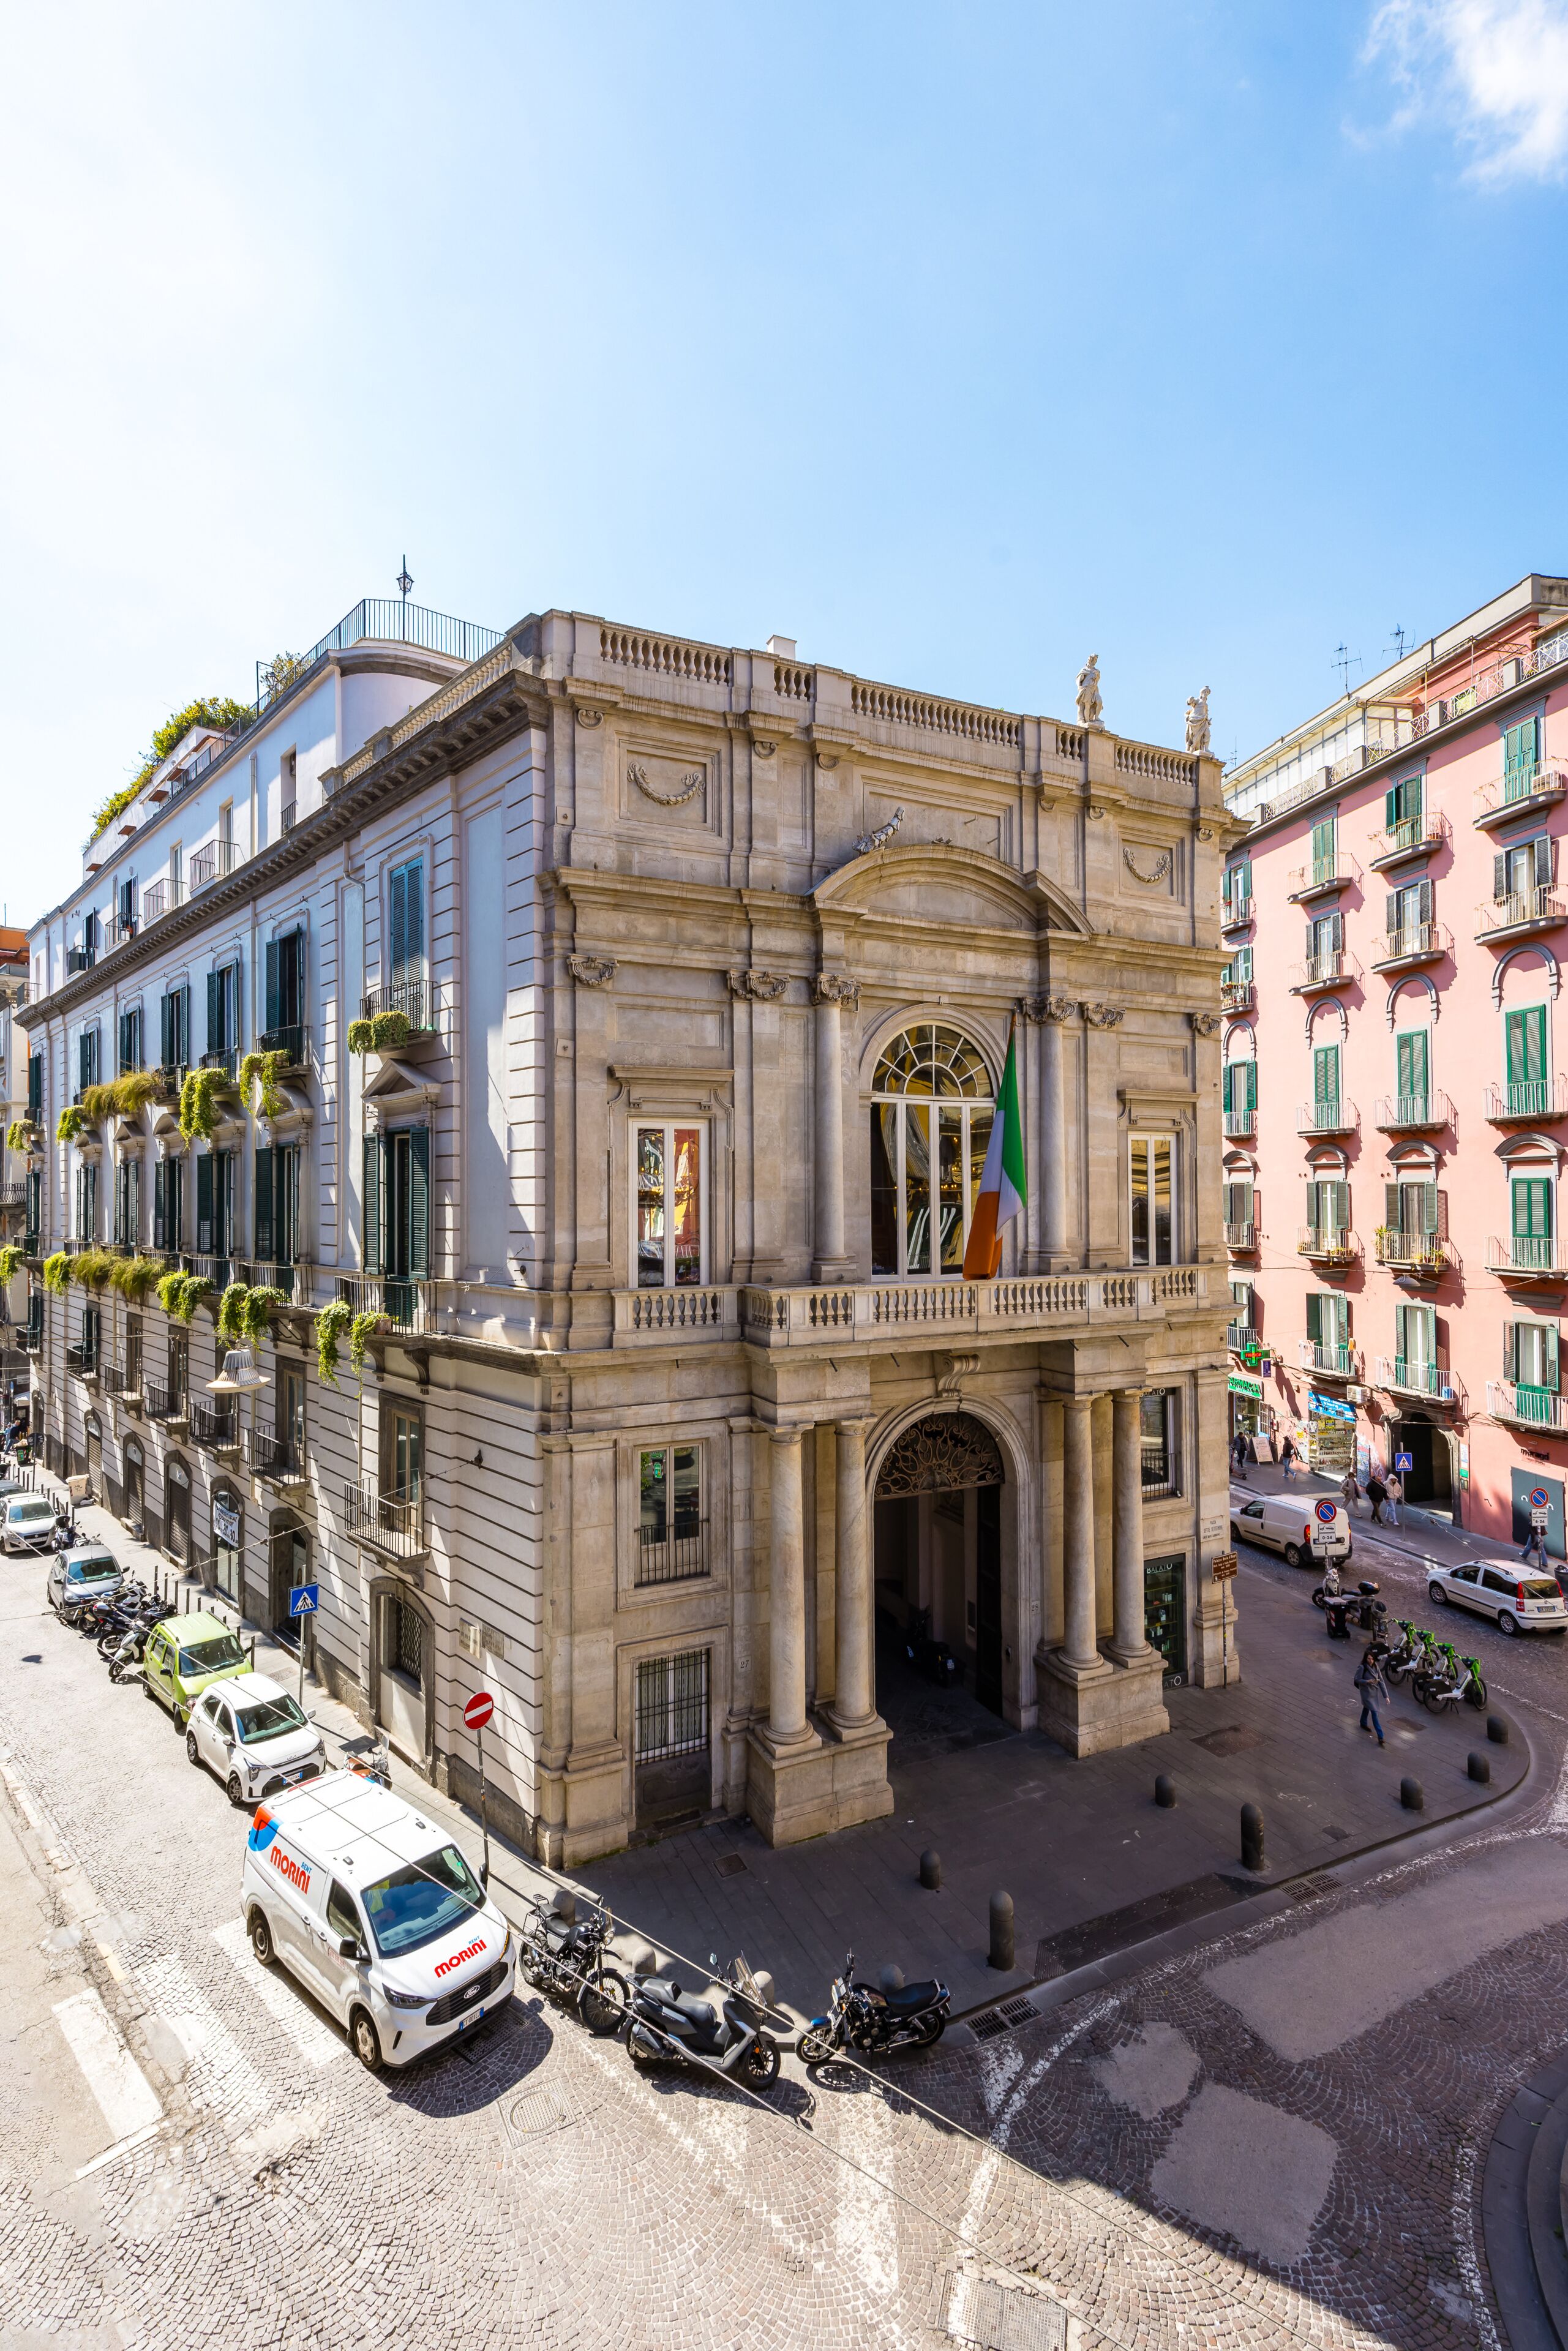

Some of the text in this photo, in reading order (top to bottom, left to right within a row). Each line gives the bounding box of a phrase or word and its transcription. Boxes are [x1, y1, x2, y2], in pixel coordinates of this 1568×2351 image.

[1229, 1377, 1261, 1393] ARMACIA
[1164, 1676, 1182, 1688] ATO
[270, 1845, 310, 1895] MORINI
[301, 1861, 312, 1873] RENT
[468, 1935, 480, 1944] RENT
[434, 1939, 487, 1978] MORINI
[467, 1987, 478, 1997] Ford
